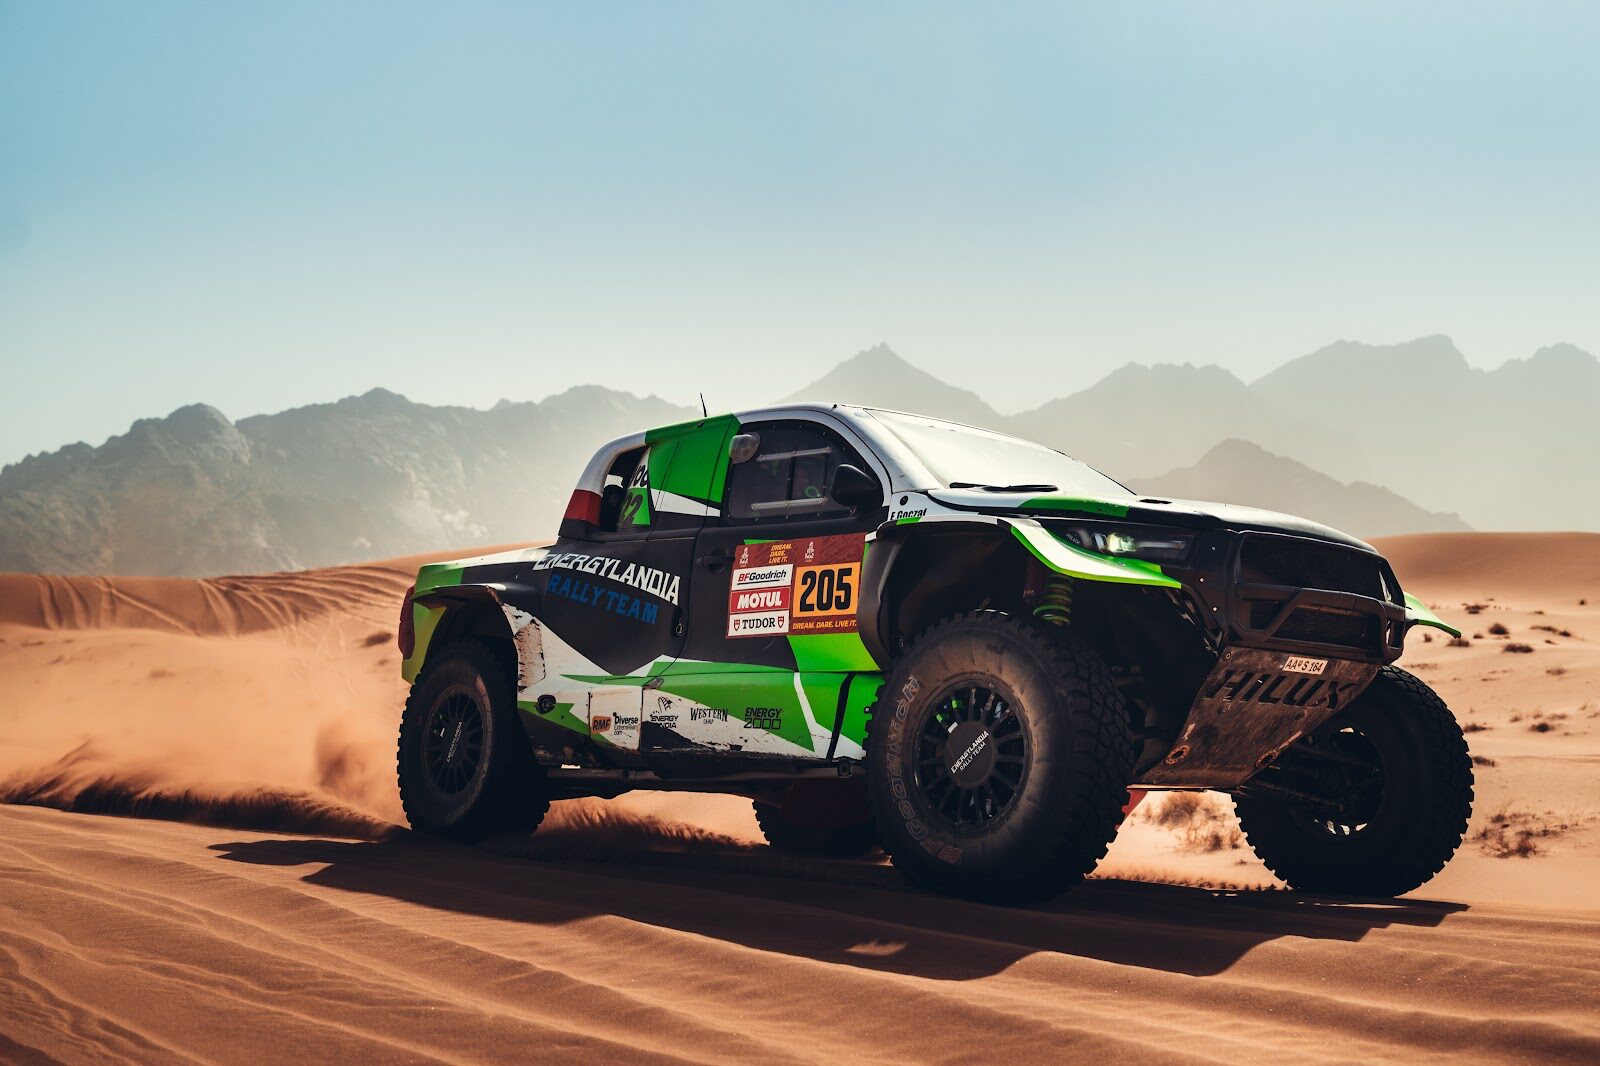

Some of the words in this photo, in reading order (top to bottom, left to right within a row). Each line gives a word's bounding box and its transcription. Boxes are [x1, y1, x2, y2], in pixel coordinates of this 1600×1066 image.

[532, 552, 681, 606] ENERGYLANDIA
[737, 569, 787, 582] BFGoodrich
[799, 567, 853, 613] 205
[547, 573, 606, 607] RALLY
[605, 590, 660, 625] TEAM
[736, 591, 783, 610] MOTUL
[742, 617, 776, 630] TUDOR
[792, 622, 816, 630] DREAM.
[816, 620, 834, 629] DARE.
[835, 619, 849, 628] LIVE
[1308, 661, 1324, 672] 164
[1202, 671, 1357, 710] HILUX
[614, 715, 639, 725] Diverse
[690, 707, 728, 722] WESTERN
[744, 707, 783, 719] ENERGY
[592, 719, 611, 731] RMF
[743, 718, 782, 730] 2000
[950, 730, 989, 774] ENERGYLANDIA
[960, 754, 974, 771] RALLY
[972, 741, 986, 757] TEAM
